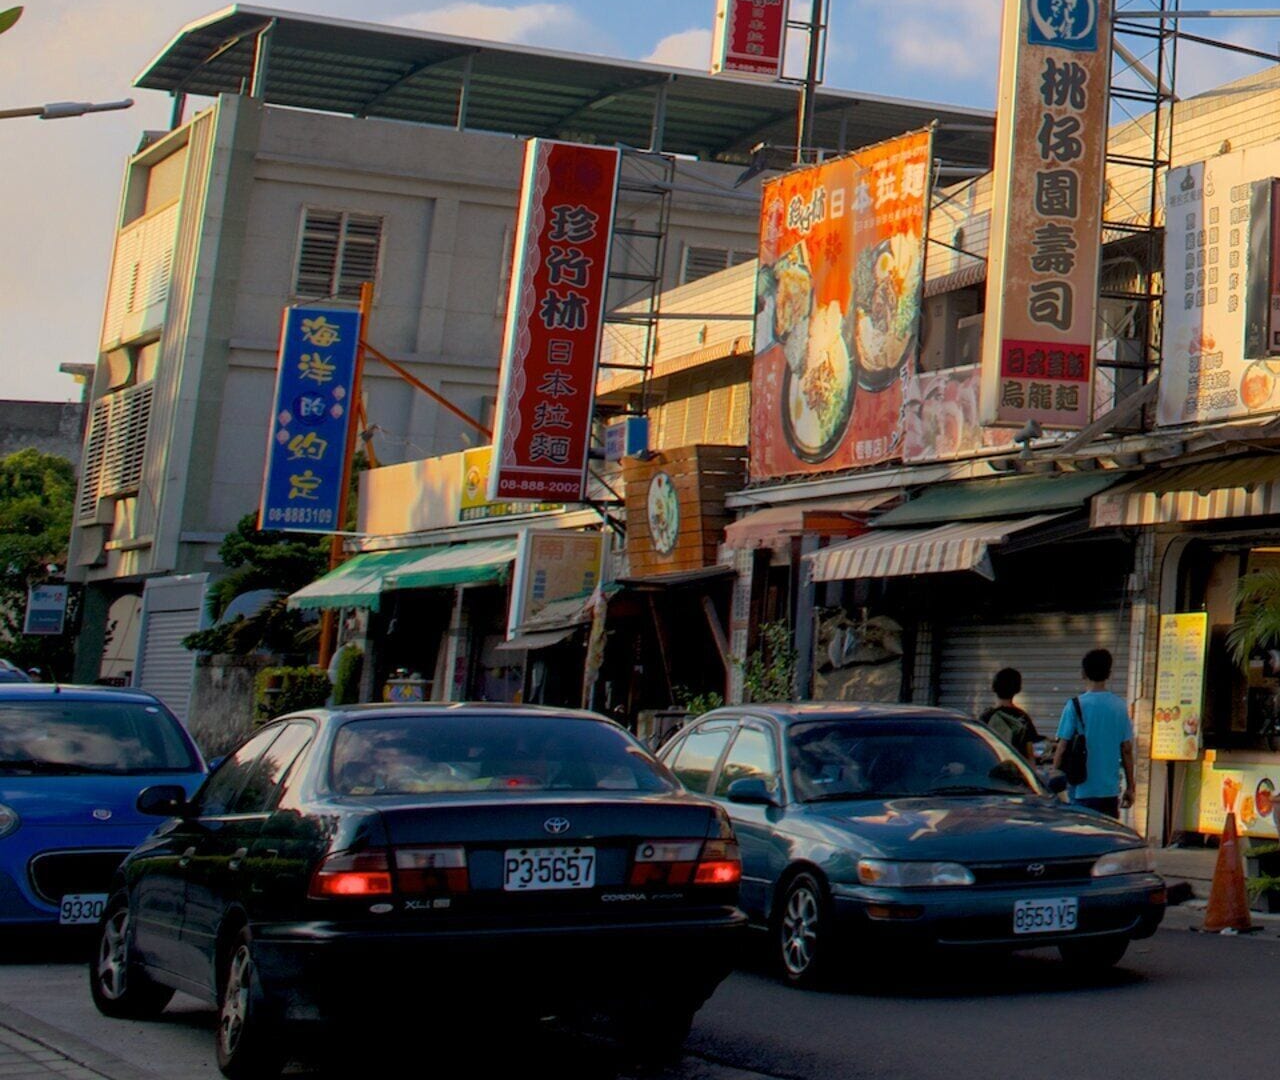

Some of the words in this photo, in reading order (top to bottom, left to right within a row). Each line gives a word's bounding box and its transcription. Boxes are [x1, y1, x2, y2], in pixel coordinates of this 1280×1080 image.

[1028, 56, 1089, 332] 桃仔園壽司
[540, 204, 599, 331] 珍竹林
[287, 315, 341, 500] 海洋的約定
[529, 339, 576, 465] 日本拉麵
[1001, 380, 1080, 411] 烏龍麵
[499, 478, 580, 495] 08-888-2002
[600, 893, 648, 903] CORONA
